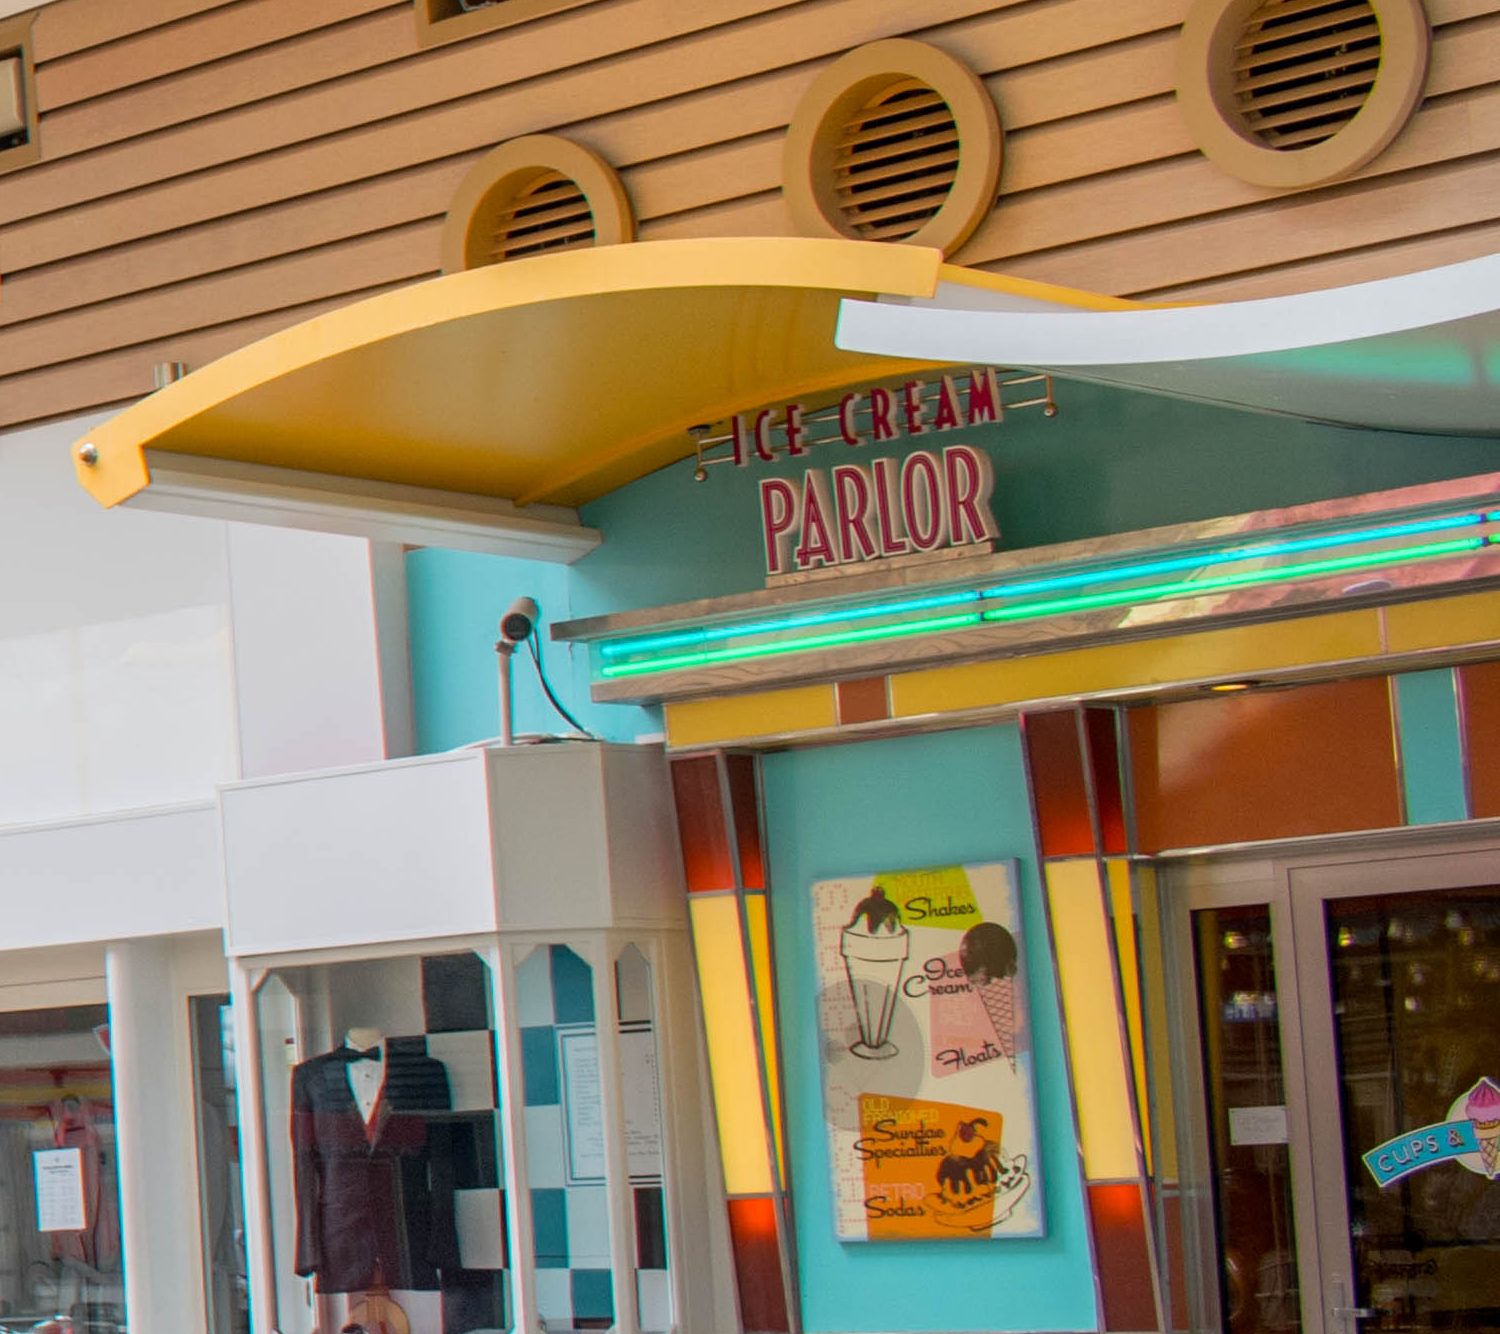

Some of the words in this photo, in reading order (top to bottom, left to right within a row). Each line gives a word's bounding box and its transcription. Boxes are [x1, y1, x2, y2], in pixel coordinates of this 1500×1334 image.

[731, 403, 805, 466] ICE
[838, 367, 1000, 447] CREAM
[758, 444, 994, 575] PARLOR
[904, 896, 976, 921] Shakes
[922, 957, 964, 981] Ice
[902, 975, 973, 998] Cream
[935, 1040, 1002, 1070] Floats
[872, 1118, 945, 1143] Sundae
[853, 1137, 947, 1168] Specialties
[1377, 1133, 1440, 1174] CUPS
[1447, 1128, 1465, 1146] &
[864, 1195, 926, 1218] Sodas
